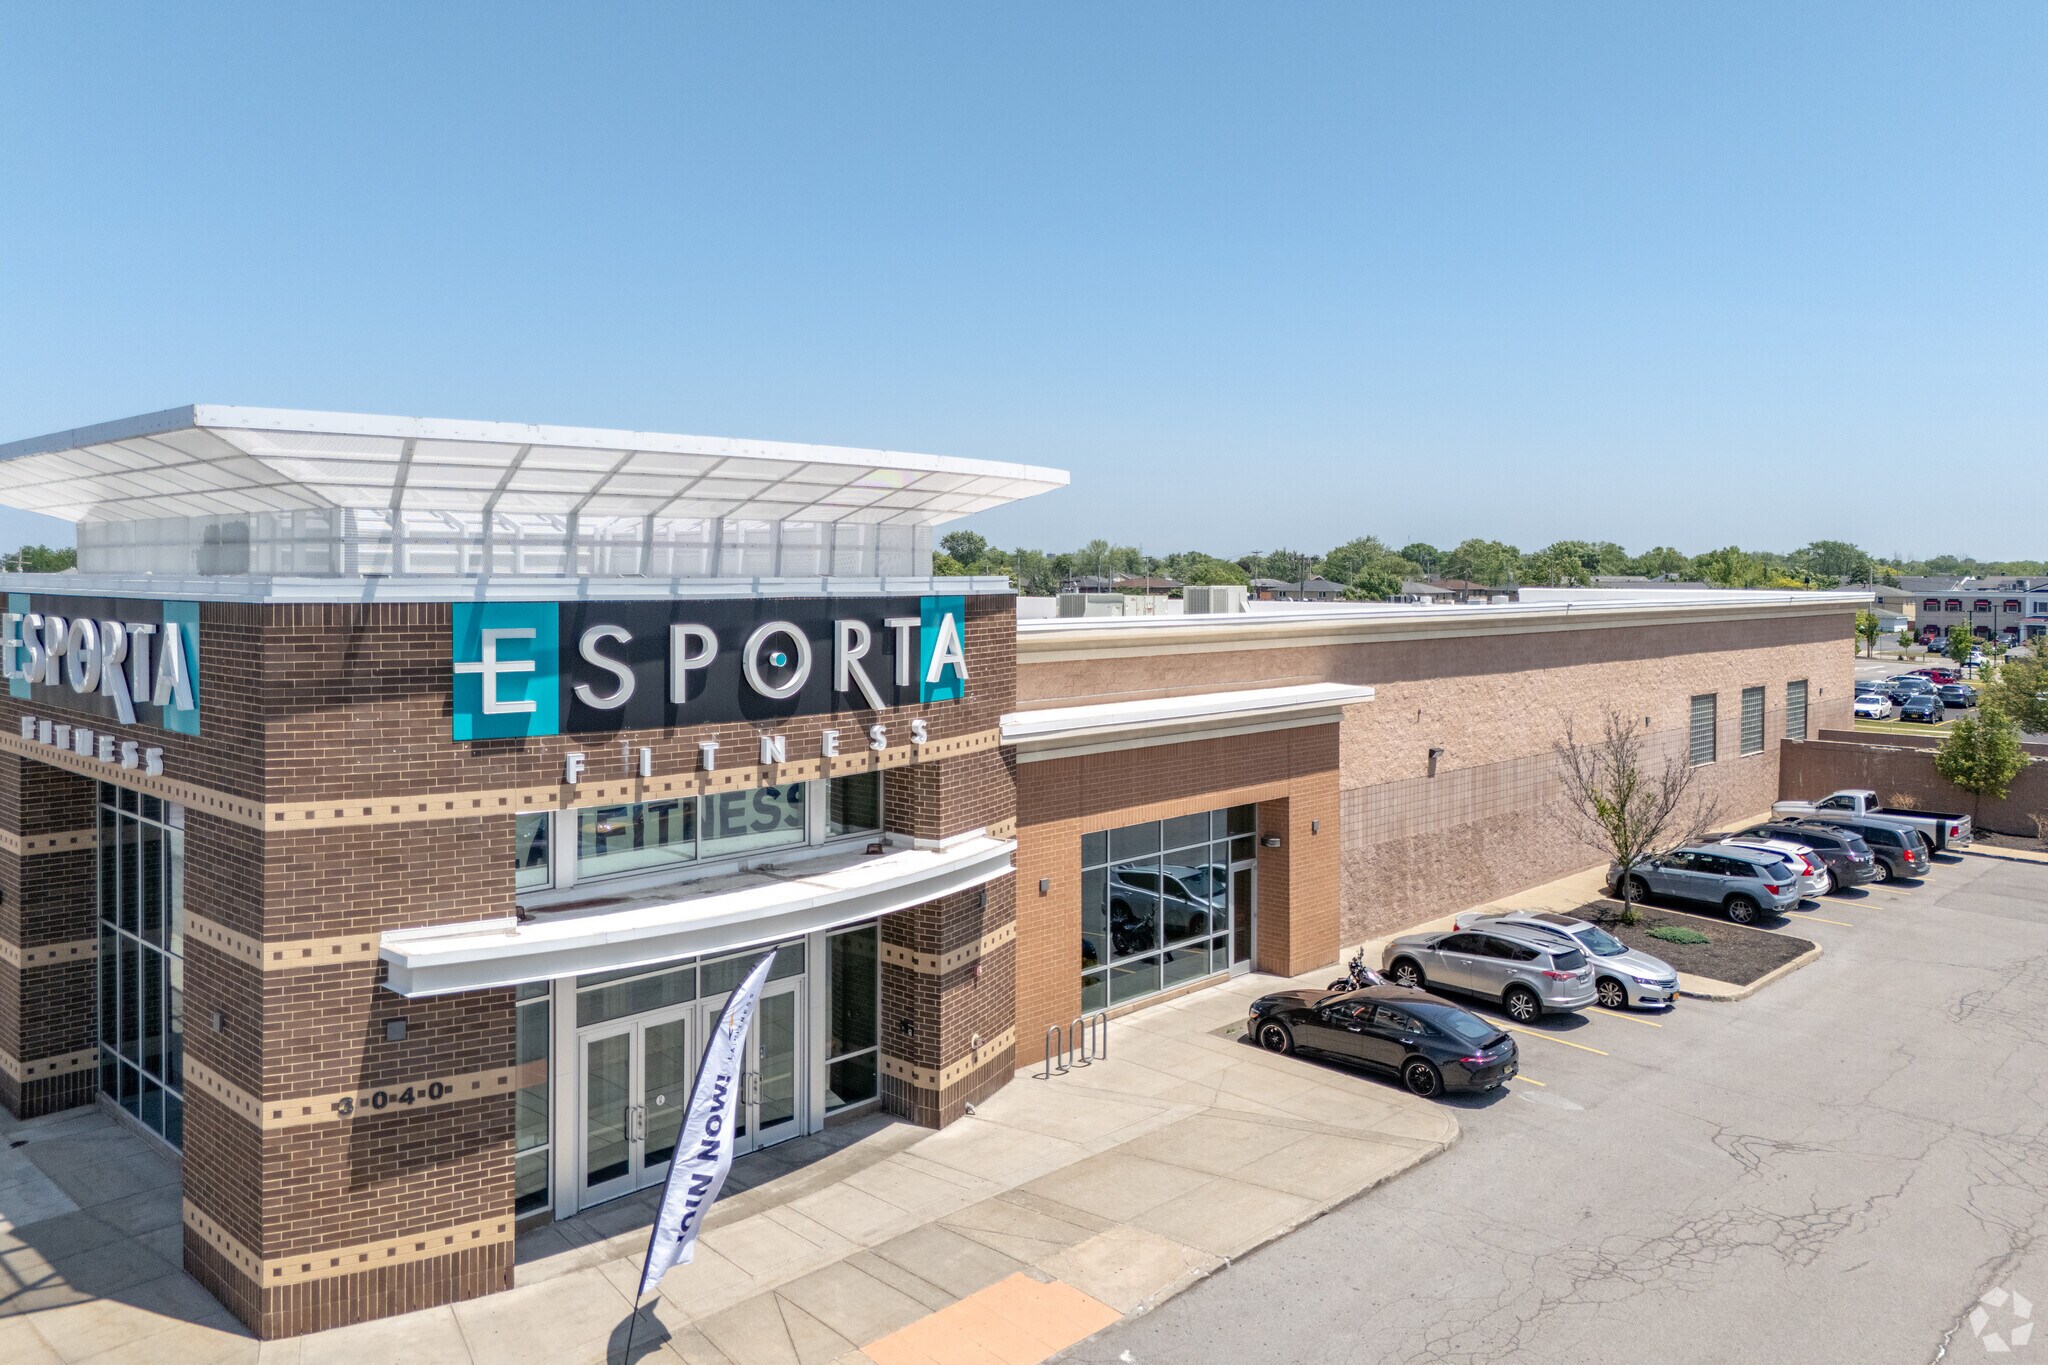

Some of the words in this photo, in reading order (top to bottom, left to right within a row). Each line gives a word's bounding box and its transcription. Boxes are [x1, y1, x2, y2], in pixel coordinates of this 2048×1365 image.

[1, 612, 195, 724] ESPORTA
[454, 612, 969, 714] ESPORTA
[21, 716, 164, 777] FITNESS
[566, 718, 928, 783] FITNESS
[697, 1074, 731, 1162] NOW!
